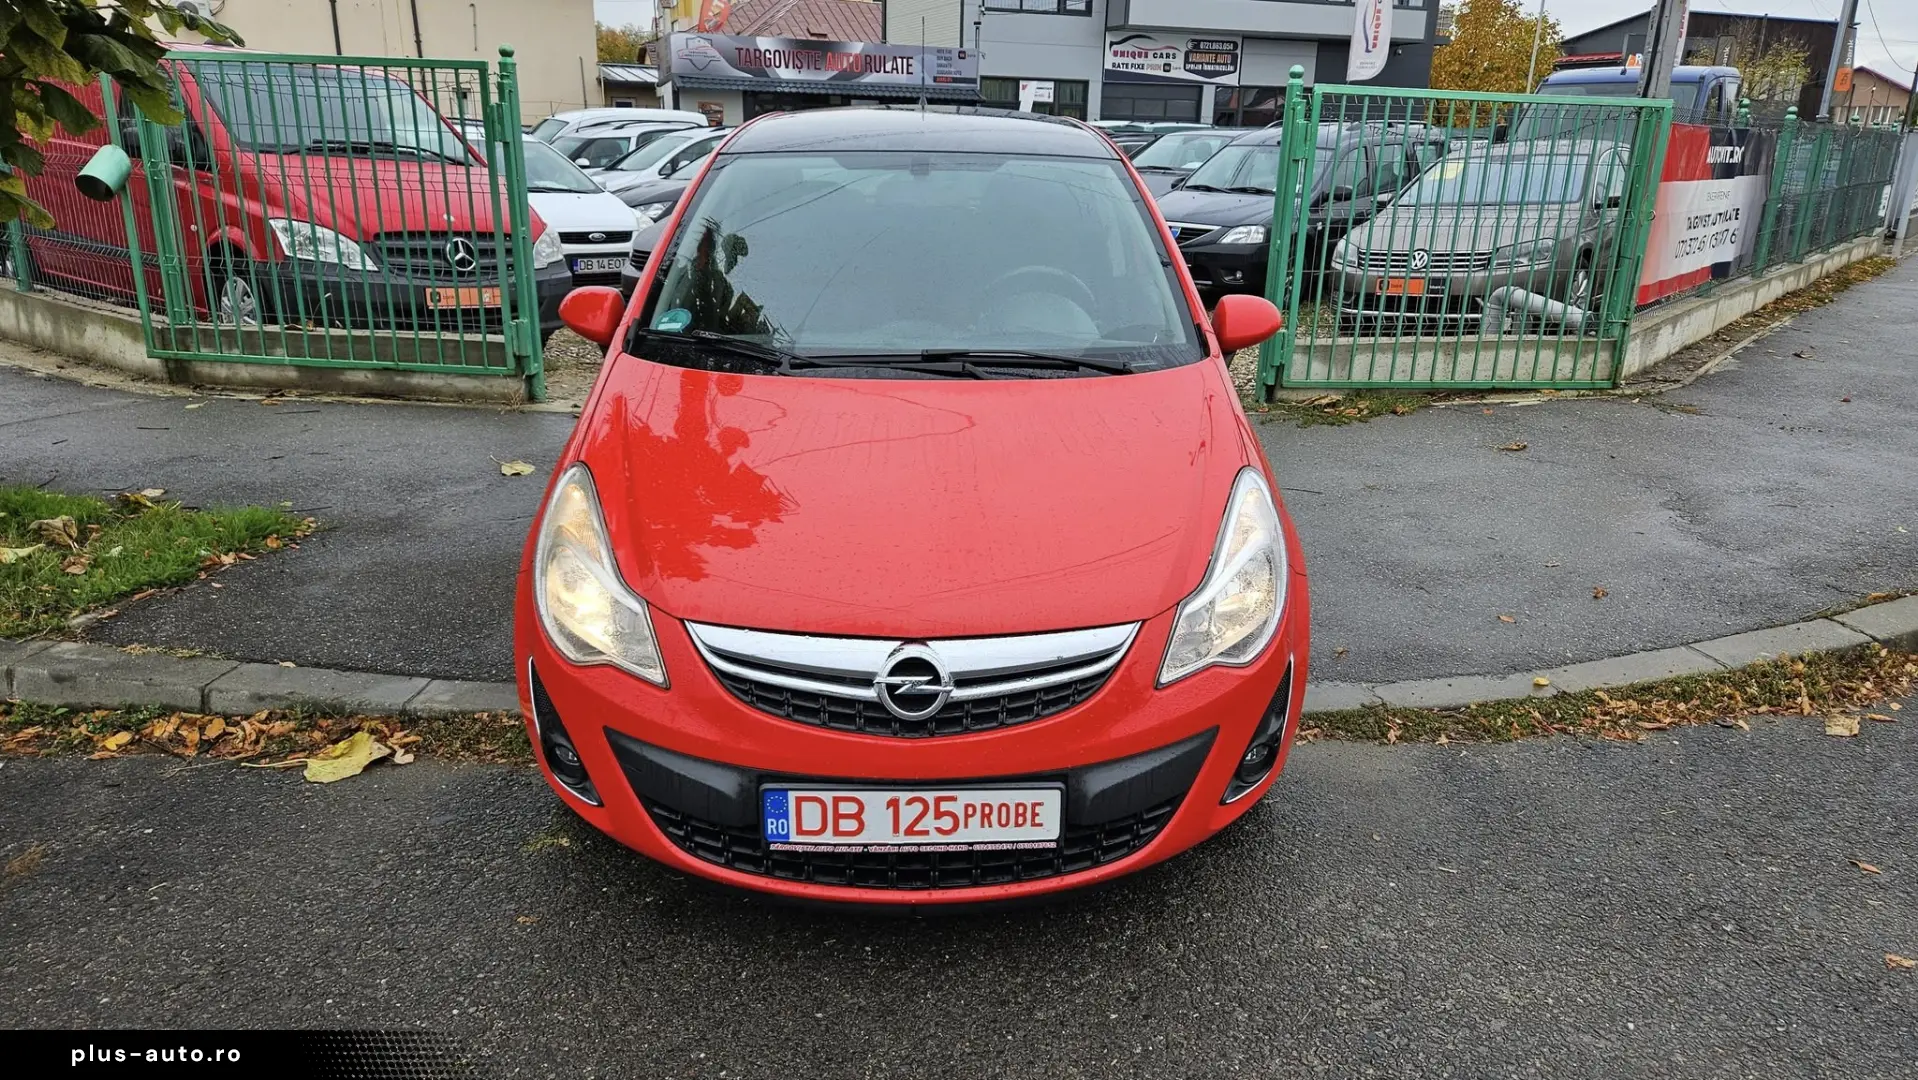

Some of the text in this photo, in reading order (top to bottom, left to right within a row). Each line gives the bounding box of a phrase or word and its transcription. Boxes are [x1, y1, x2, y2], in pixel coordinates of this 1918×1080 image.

[1112, 49, 1177, 60] UNIQUE CARS
[1217, 53, 1232, 64] AUTO
[1844, 39, 1854, 65] bank
[735, 47, 914, 75] TARGOVIȘTE AUTO RULATE
[1112, 62, 1129, 70] RATE
[579, 259, 593, 270] DB
[597, 260, 605, 269] 14
[794, 795, 1044, 837] DB 125 PROBE
[767, 818, 788, 835] RO
